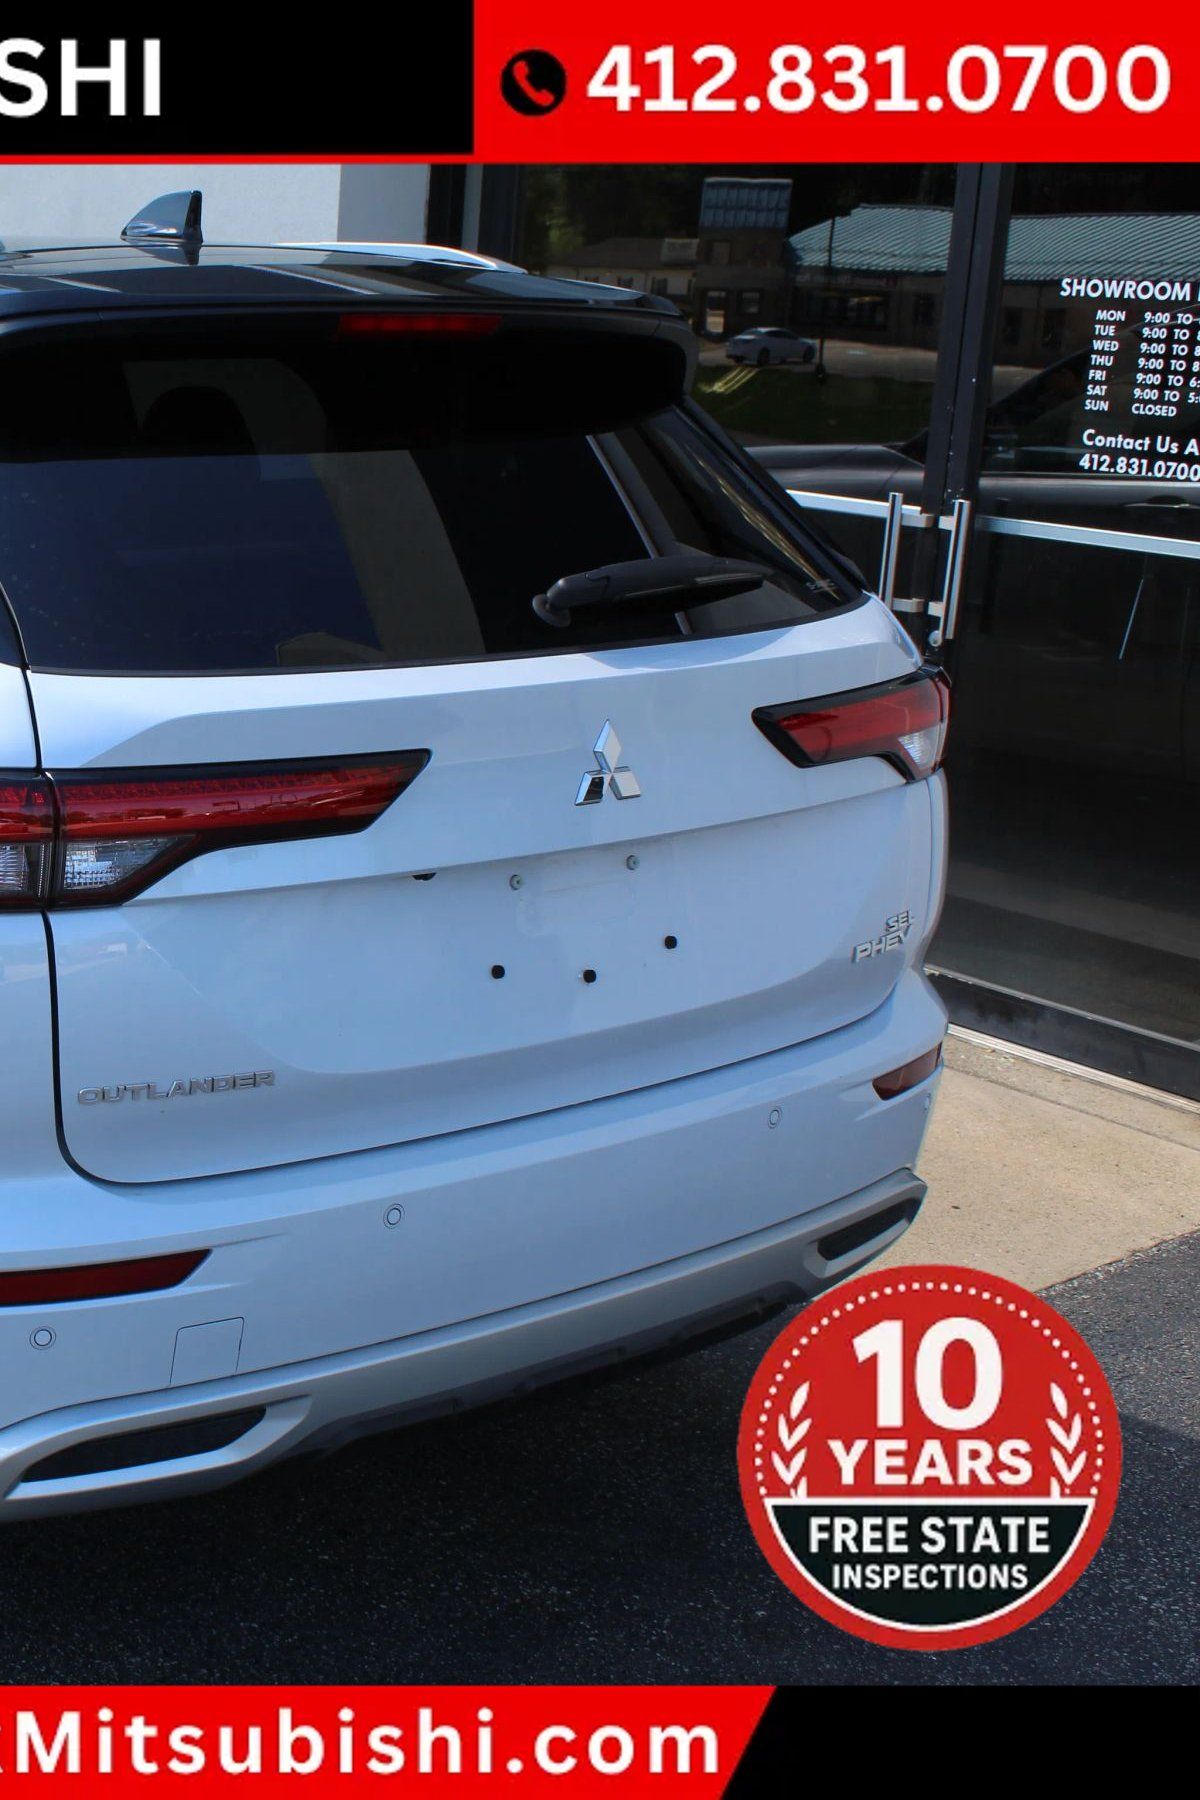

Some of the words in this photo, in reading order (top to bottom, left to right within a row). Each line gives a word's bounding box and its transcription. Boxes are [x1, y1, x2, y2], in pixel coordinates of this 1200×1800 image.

[1060, 277, 1191, 302] SHOWROOM
[1096, 309, 1126, 321] MON
[1144, 311, 1171, 324] 9:00
[1176, 313, 1194, 325] TO
[1094, 324, 1116, 336] TUE
[1142, 327, 1168, 339] 9:00
[1173, 329, 1190, 340] TO
[1092, 340, 1119, 351] WED
[1140, 342, 1166, 354] 9:00
[1172, 344, 1188, 356] TO
[1090, 354, 1114, 367] THU
[1137, 357, 1164, 369] 9:00
[1170, 360, 1187, 371] TO
[1088, 369, 1106, 381] FRI
[1136, 373, 1162, 385] 9:00
[1167, 375, 1184, 387] TO
[1086, 384, 1108, 396] SAT
[1133, 388, 1159, 400] 9:00
[1163, 390, 1180, 402] TO
[1084, 399, 1109, 412] SUN
[1131, 403, 1177, 417] CLOSED
[1082, 428, 1151, 451] Contact
[1155, 435, 1180, 454] Us
[1079, 453, 1200, 482] 412.831.0700
[886, 910, 910, 932] SE
[851, 924, 912, 964] PHEV
[78, 1069, 275, 1105] OUTLANDER
